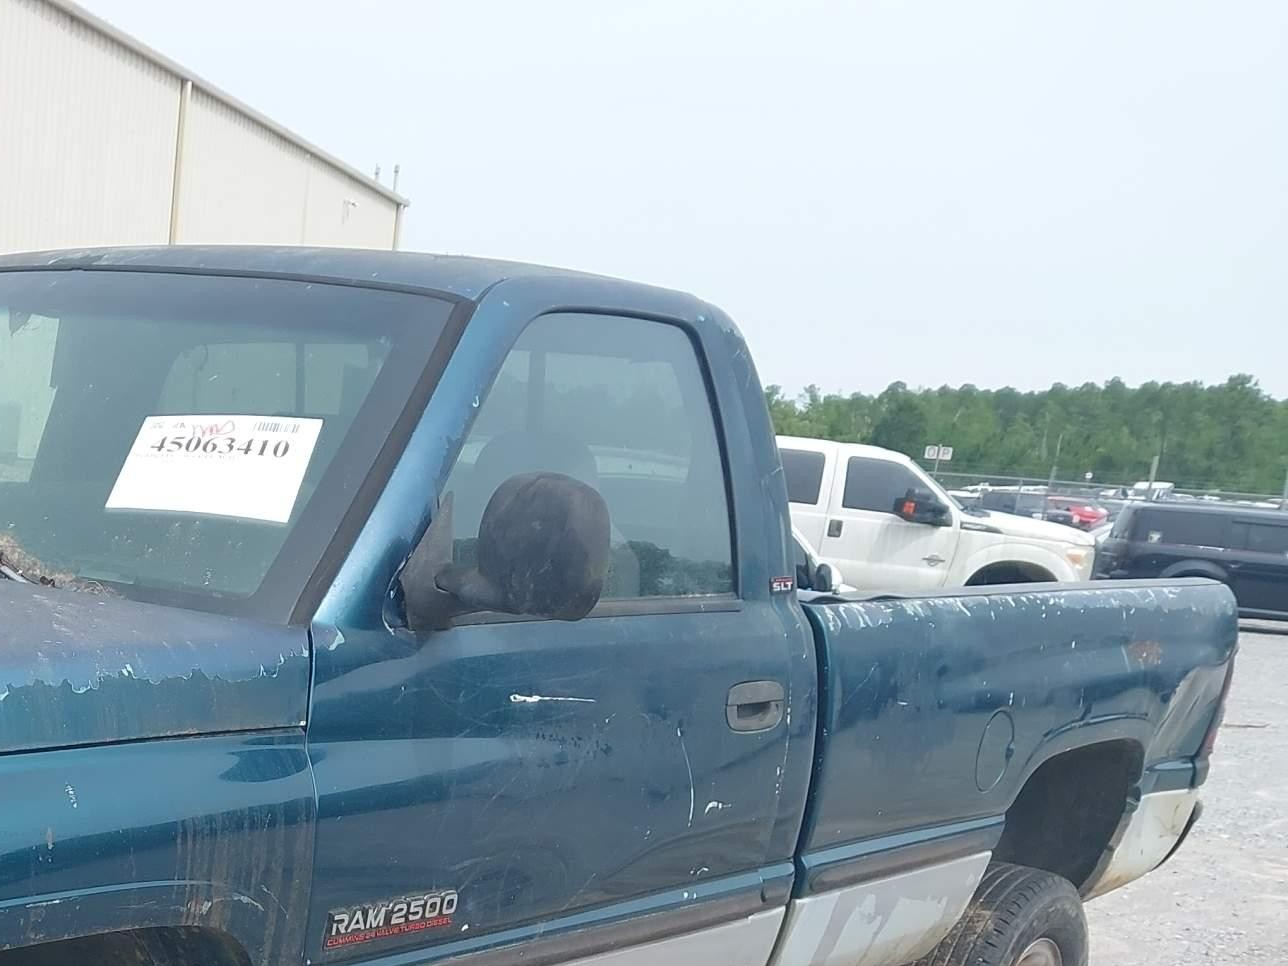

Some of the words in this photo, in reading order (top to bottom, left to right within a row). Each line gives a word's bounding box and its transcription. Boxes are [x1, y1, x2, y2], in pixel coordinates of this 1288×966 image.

[150, 435, 290, 458] 45063410
[772, 581, 793, 591] SLT
[331, 906, 389, 936] RAM
[390, 891, 459, 926] 2500
